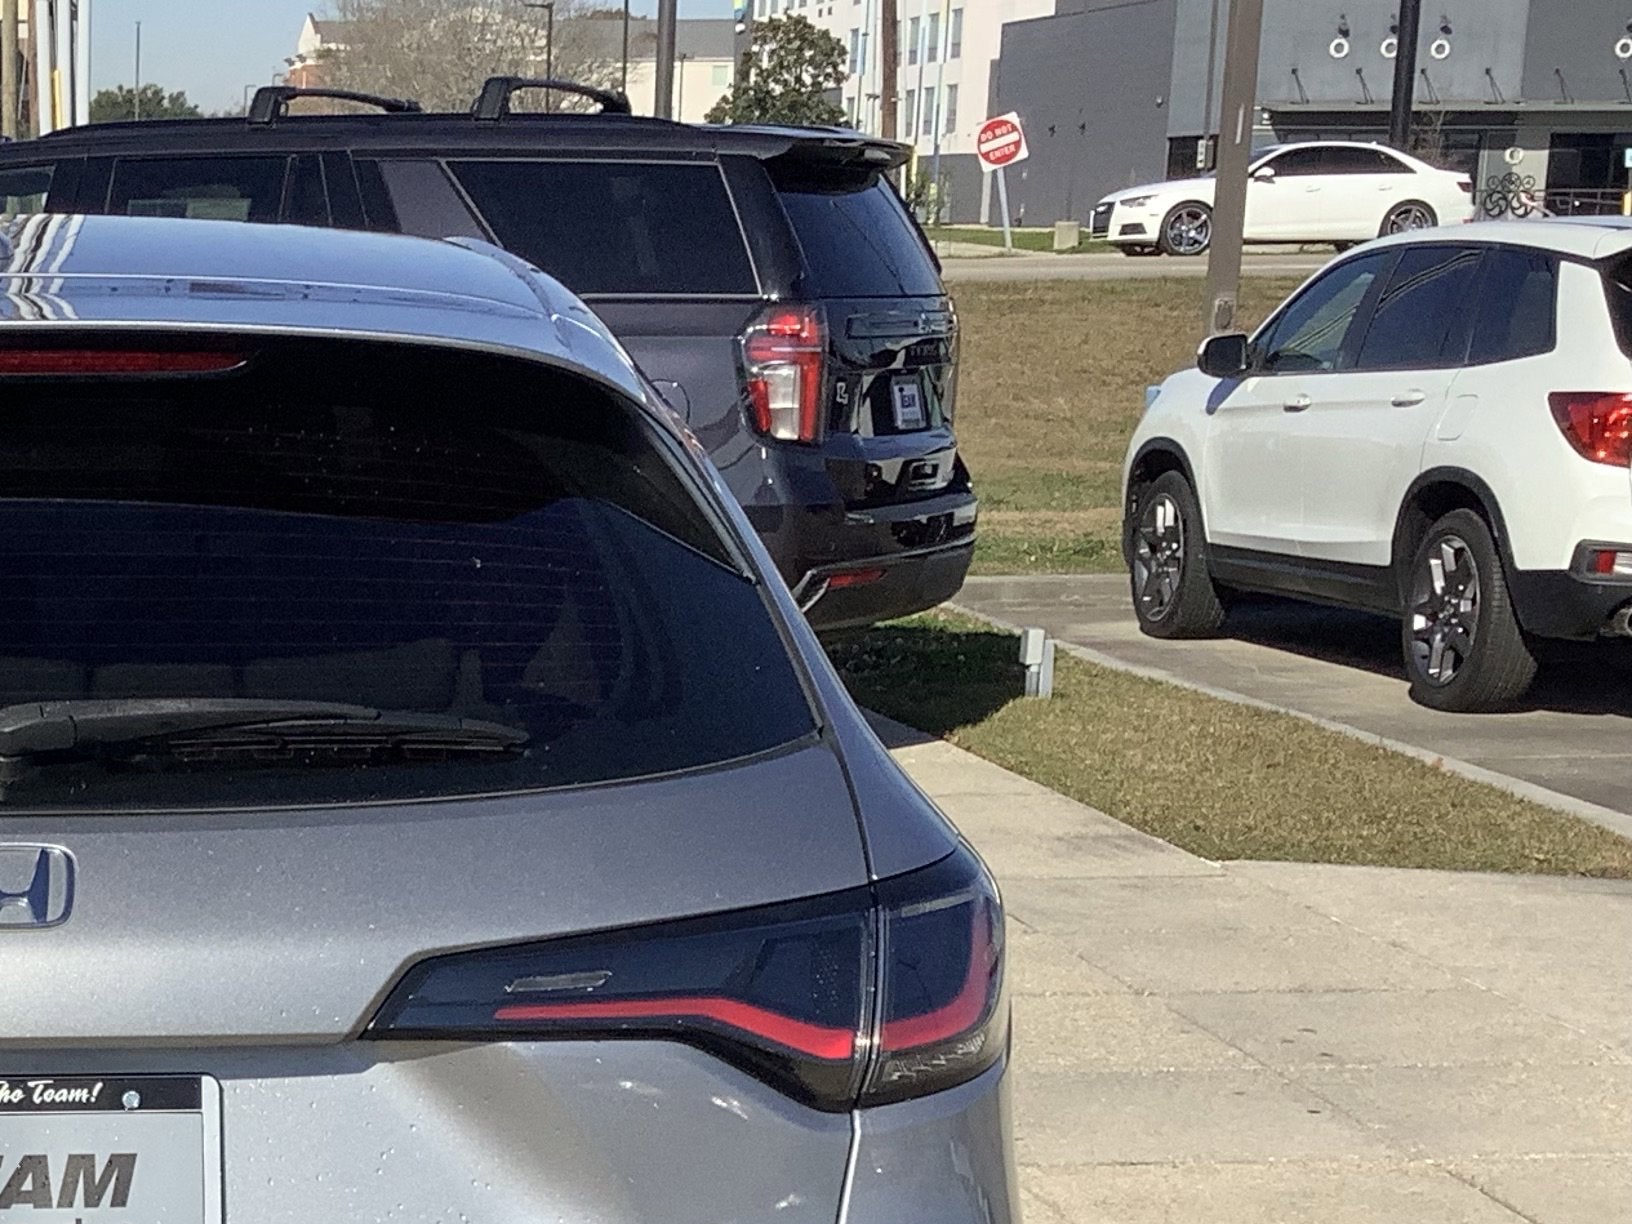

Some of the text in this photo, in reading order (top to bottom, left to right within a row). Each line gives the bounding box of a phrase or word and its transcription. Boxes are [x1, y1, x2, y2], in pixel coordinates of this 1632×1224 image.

[980, 123, 1013, 142] DO NOT
[989, 144, 1016, 161] ENTER
[27, 1081, 104, 1105] Team!
